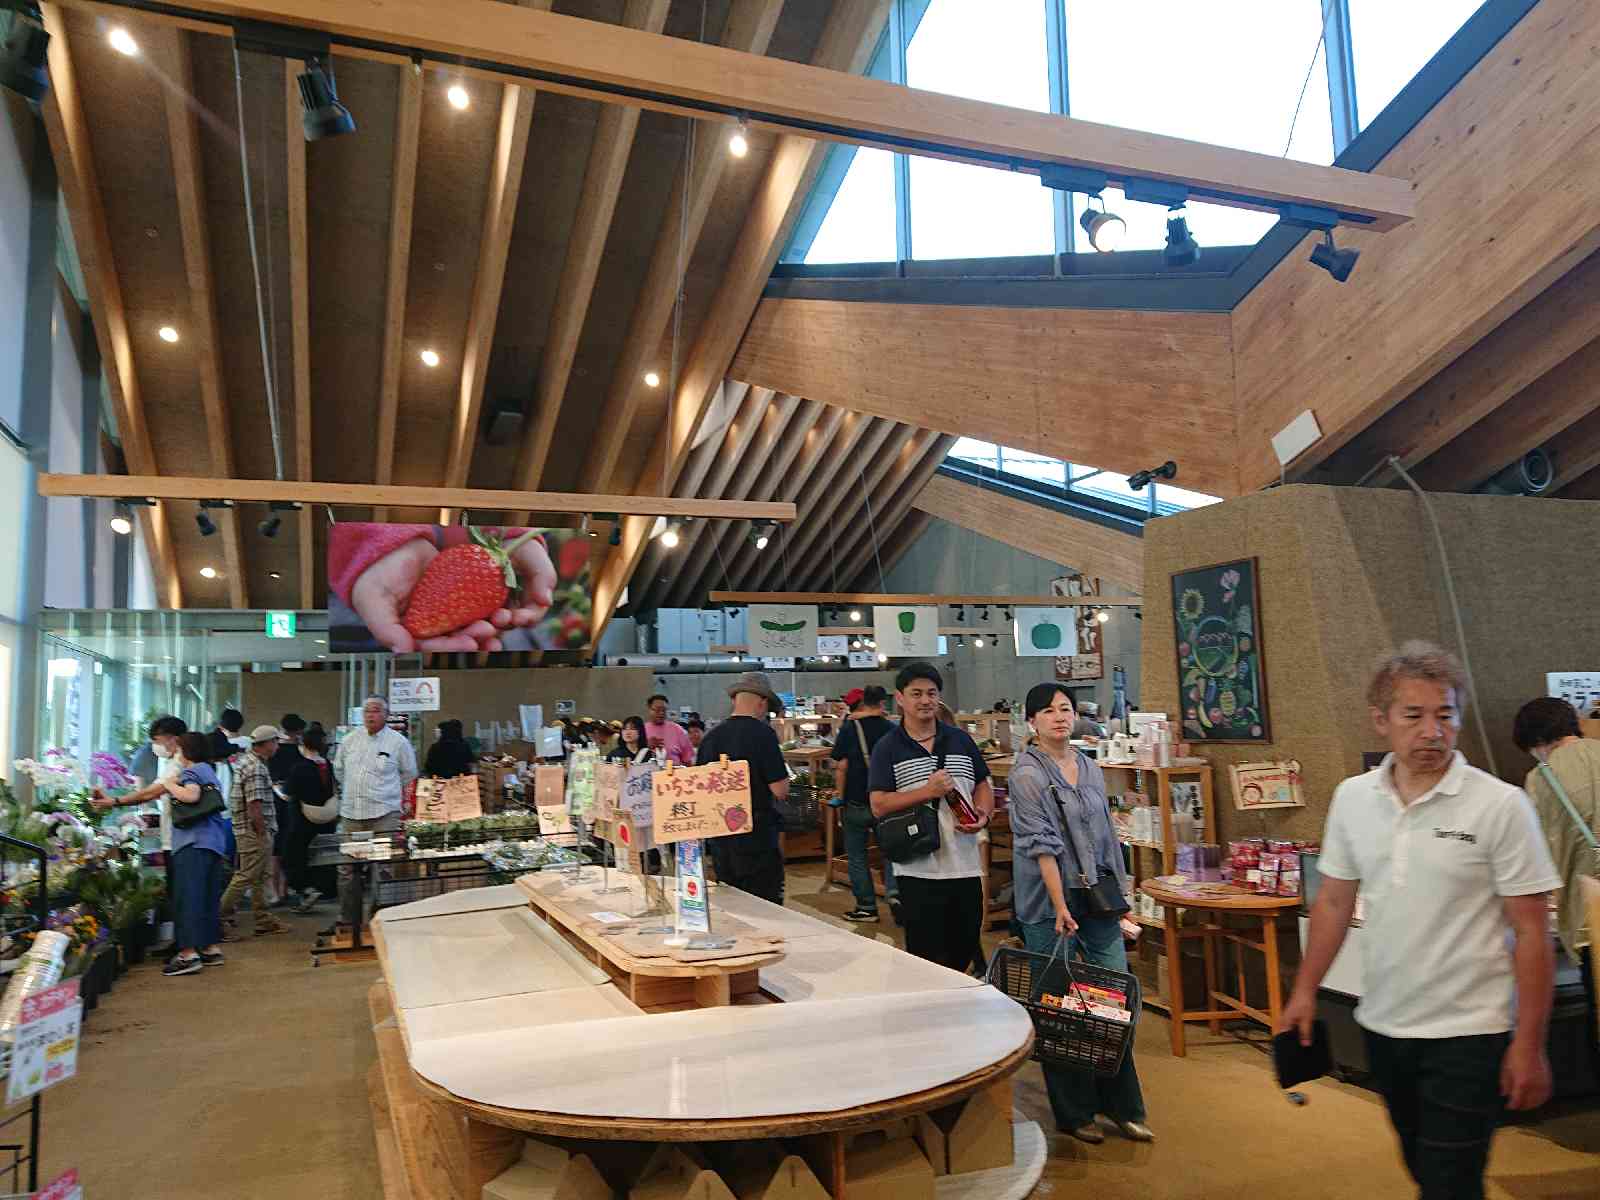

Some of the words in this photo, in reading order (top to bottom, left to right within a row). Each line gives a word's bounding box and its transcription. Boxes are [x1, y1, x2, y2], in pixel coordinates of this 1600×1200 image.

[656, 768, 748, 797] いちごの発送
